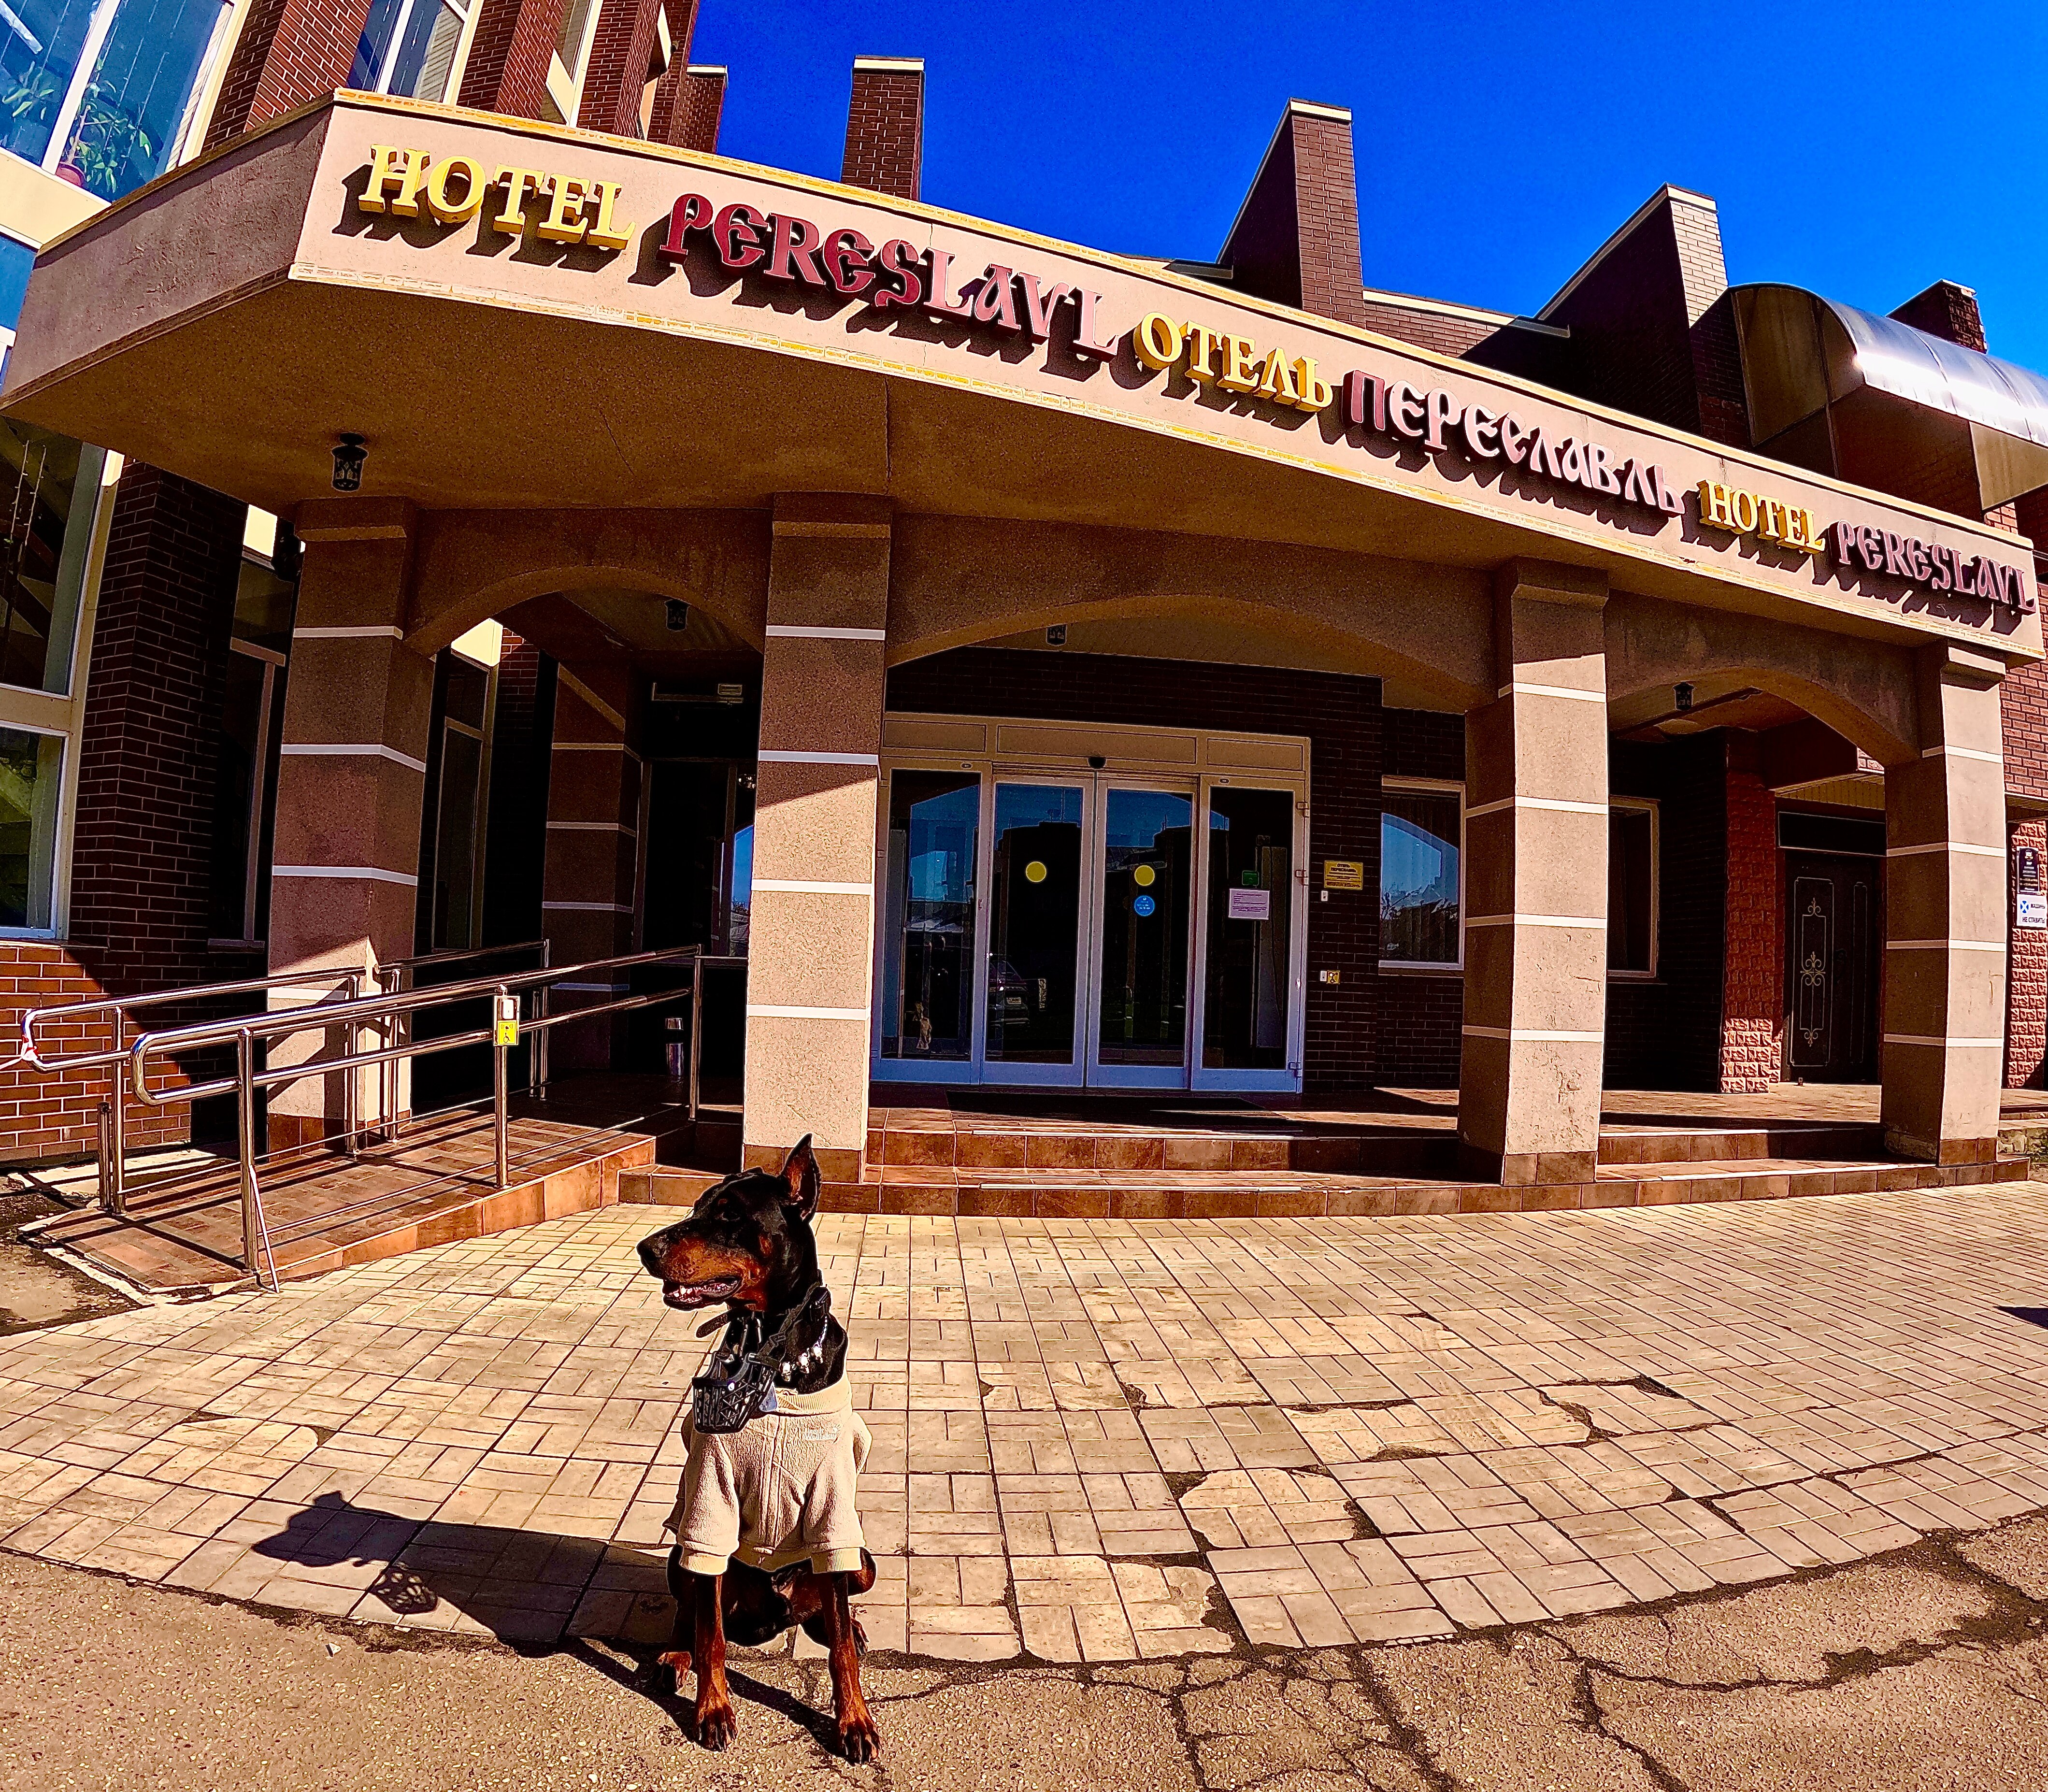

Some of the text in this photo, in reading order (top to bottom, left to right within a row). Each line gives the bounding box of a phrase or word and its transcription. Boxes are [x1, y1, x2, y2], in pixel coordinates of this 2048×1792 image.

[358, 143, 1118, 361] HOTEL PERESLAVL
[1133, 311, 1686, 515] ОТЕЛЬ ПЕРЕСЛАВЛЬ
[1696, 479, 2036, 614] HOTEL PERESLAVL
